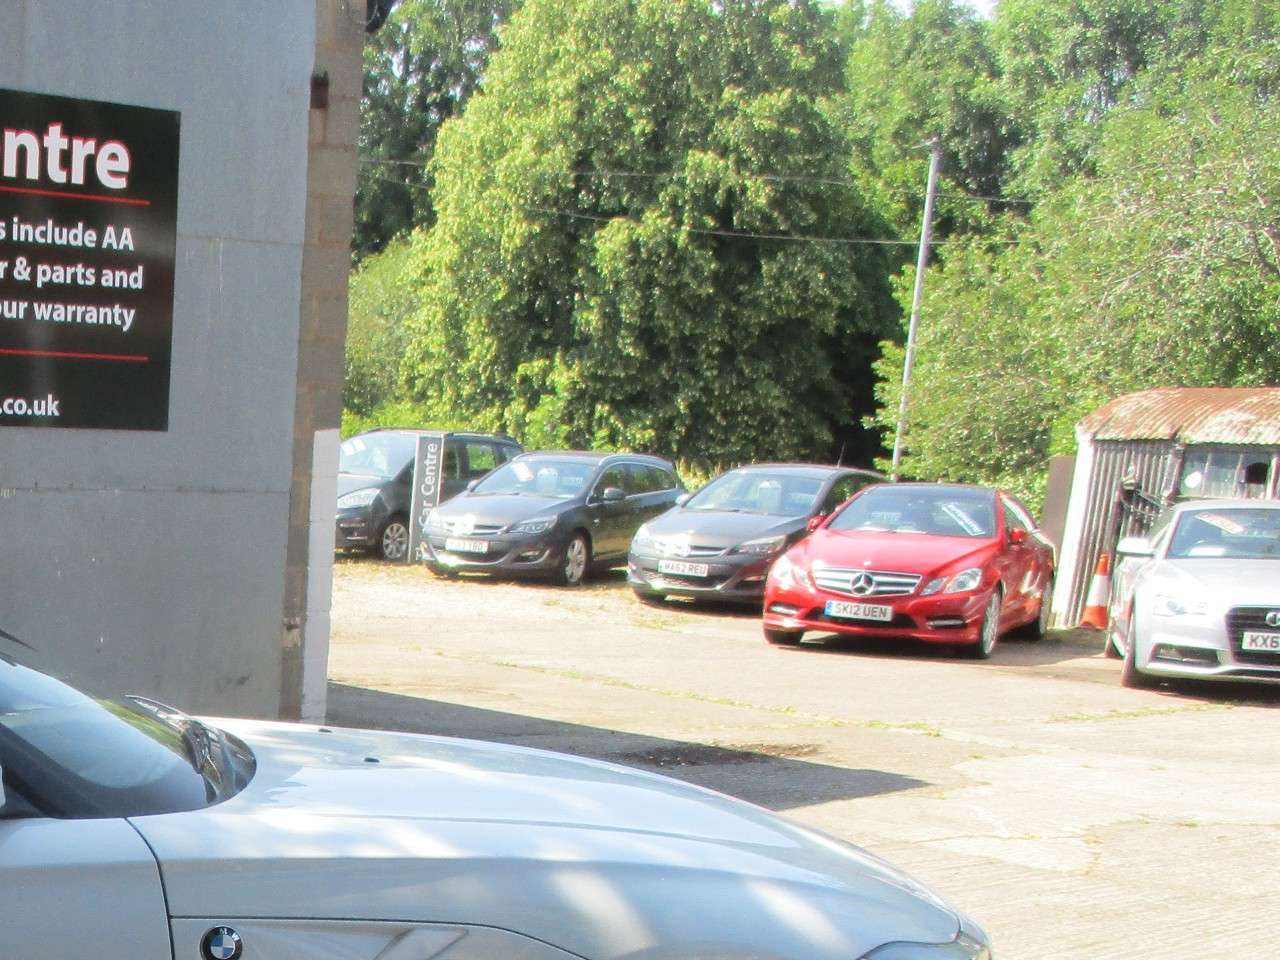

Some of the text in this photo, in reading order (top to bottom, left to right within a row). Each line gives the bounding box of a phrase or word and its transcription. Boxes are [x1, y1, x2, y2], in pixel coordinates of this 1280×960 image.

[12, 216, 98, 248] include
[101, 225, 135, 252] AA
[13, 259, 32, 281] &
[36, 263, 96, 288] parts
[100, 265, 144, 290] and
[32, 302, 136, 332] warranty
[421, 443, 438, 496] Centre
[834, 602, 888, 618] SK12 UEN
